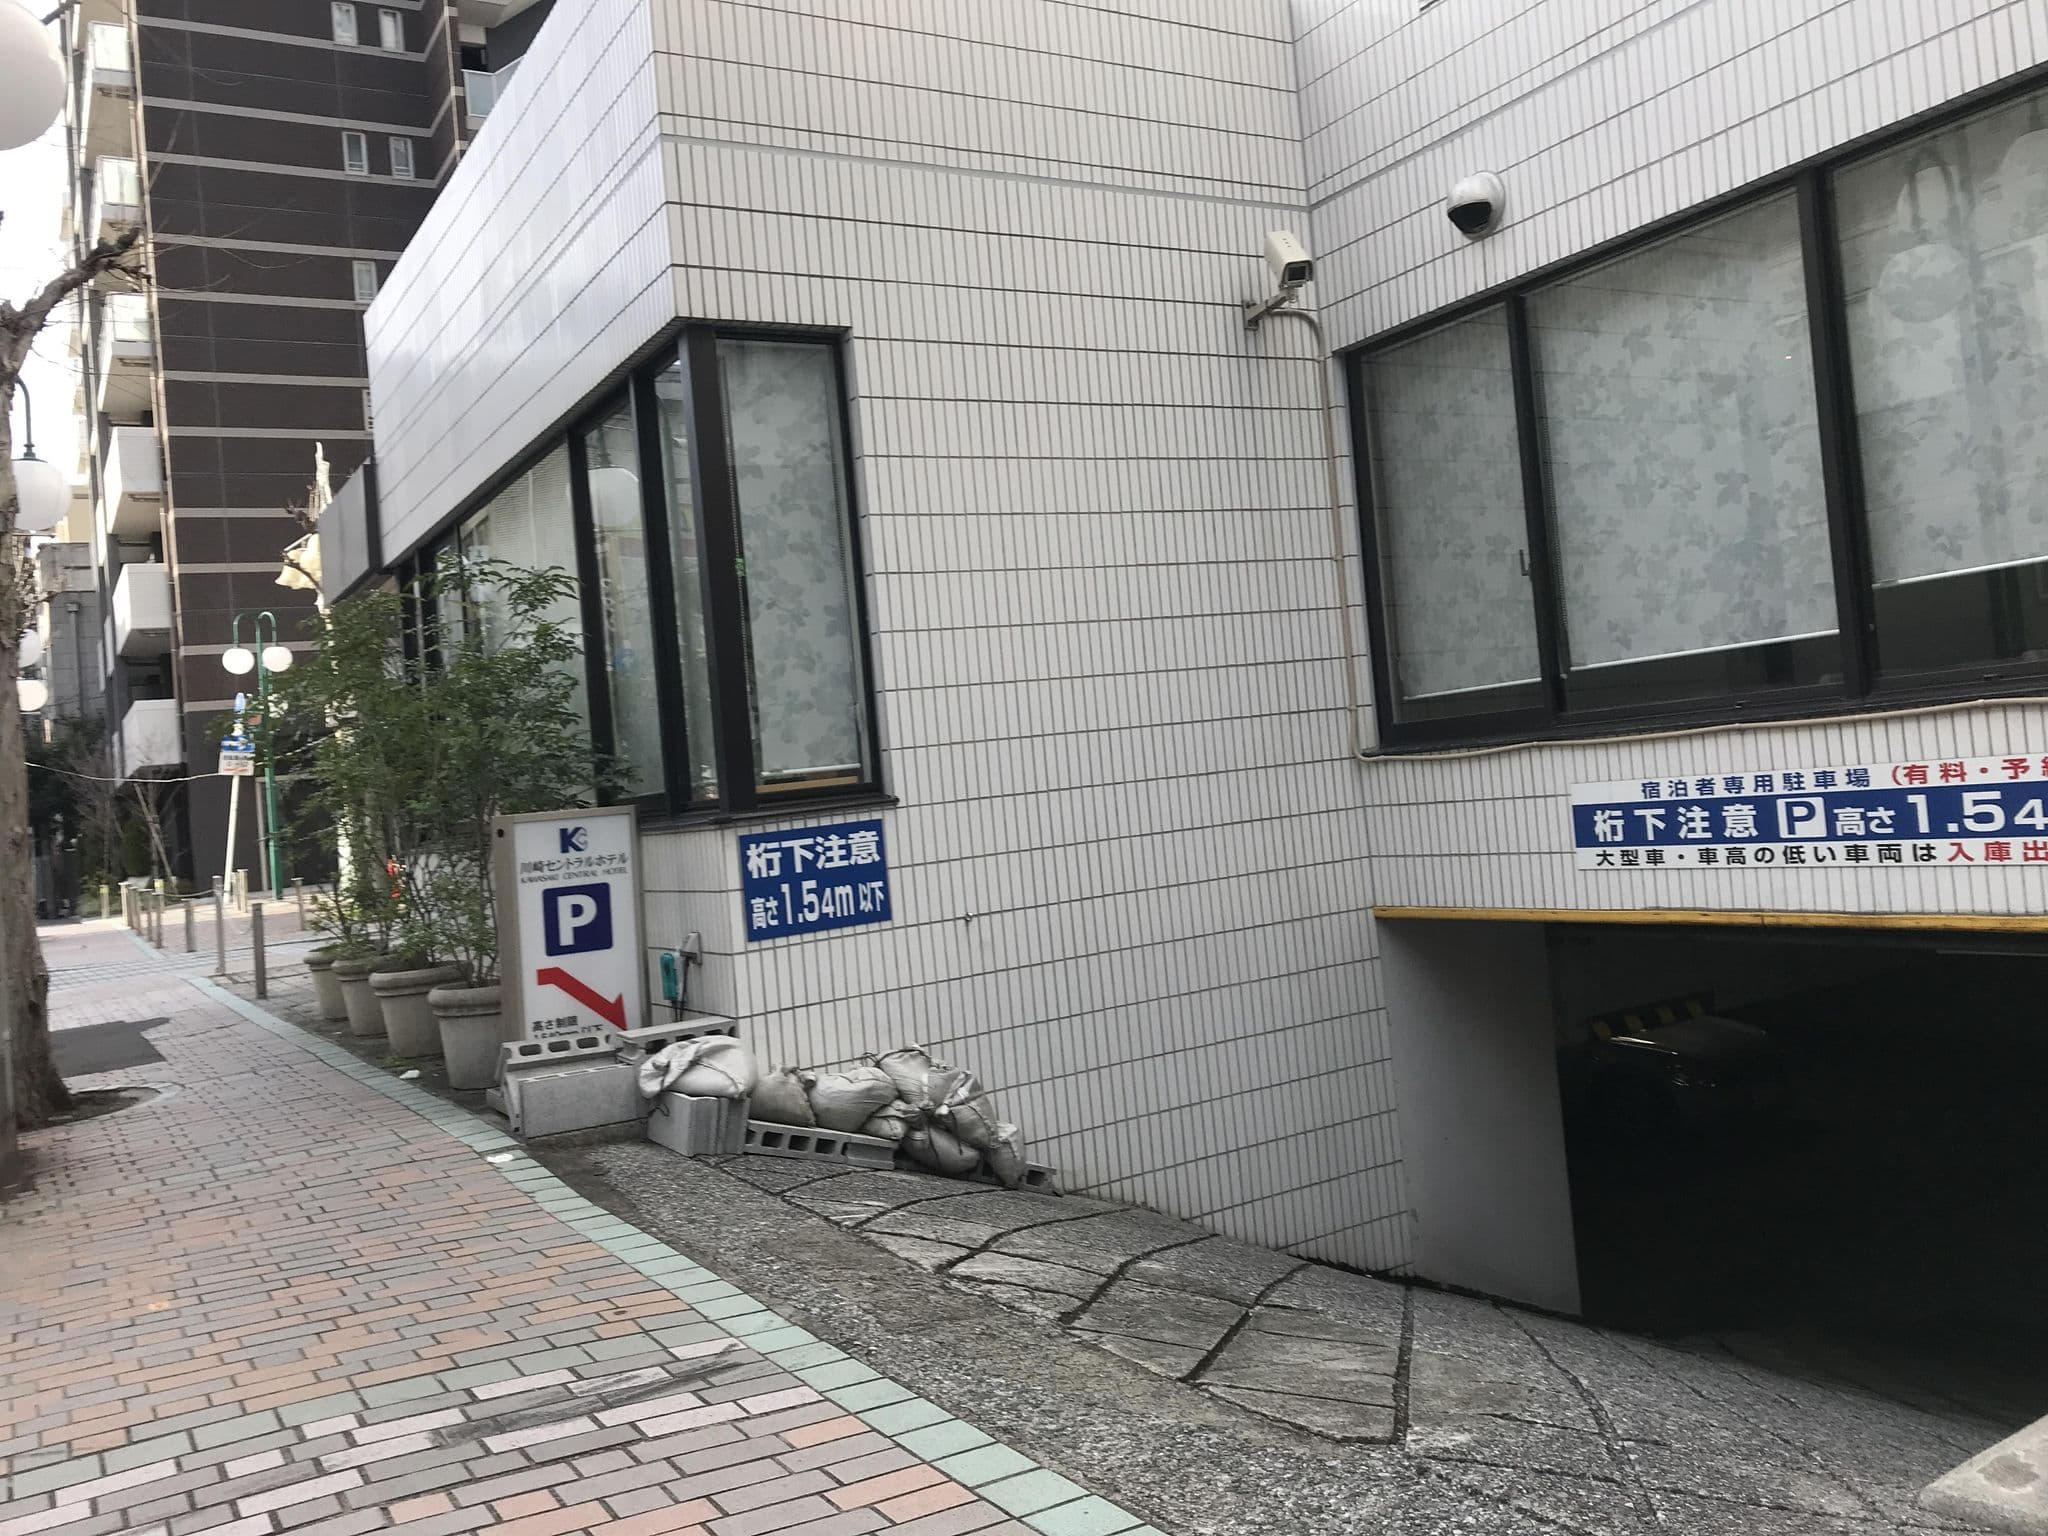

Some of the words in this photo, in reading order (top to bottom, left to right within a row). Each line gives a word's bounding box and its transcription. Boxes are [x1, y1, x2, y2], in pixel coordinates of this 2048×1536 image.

[1641, 767, 1871, 799] 宿泊者専用駐車場
[1891, 756, 2048, 786] (有料・予
[1593, 804, 1759, 842] 桁下注意
[1785, 801, 1816, 835] P
[746, 830, 881, 879] 桁下注意
[556, 894, 597, 946] P
